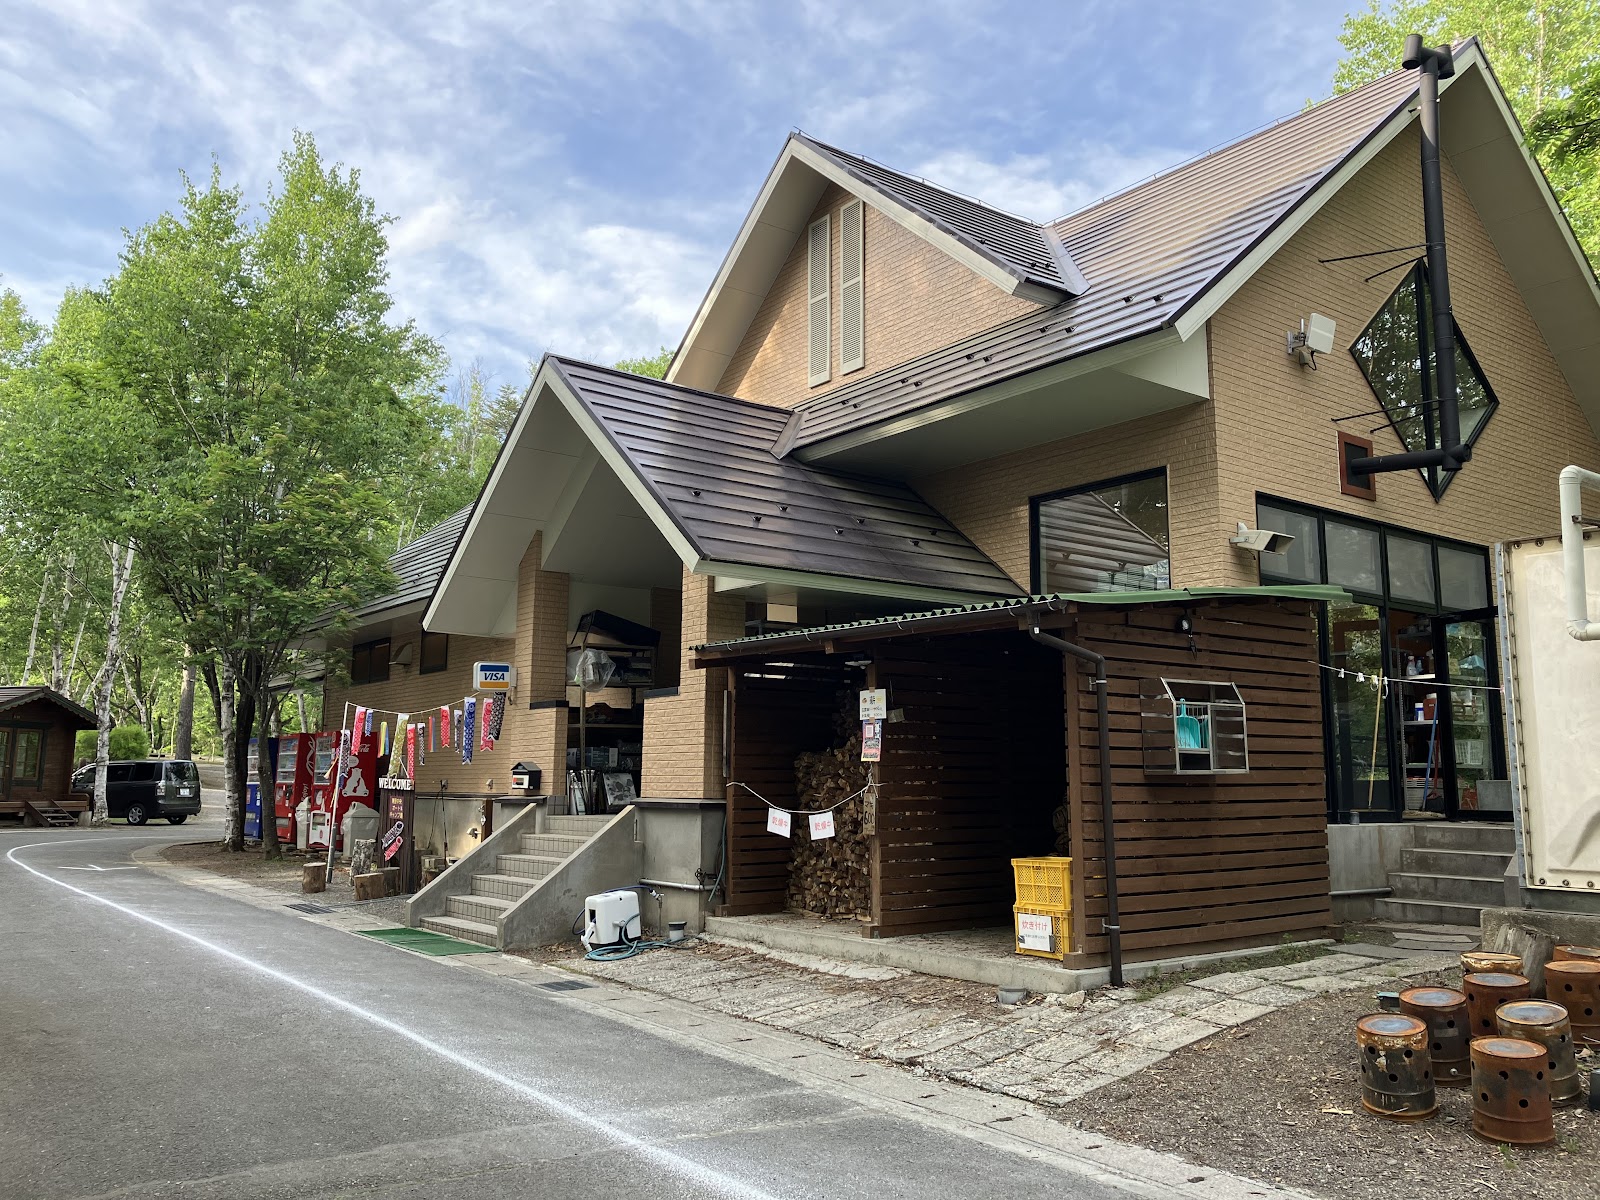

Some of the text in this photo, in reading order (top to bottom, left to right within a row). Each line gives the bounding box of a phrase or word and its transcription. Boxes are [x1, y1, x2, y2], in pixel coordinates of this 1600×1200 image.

[484, 672, 505, 681] VISA
[378, 778, 412, 791] WELCOME
[864, 811, 874, 825] 600
[1022, 920, 1048, 931] 炊き付け
